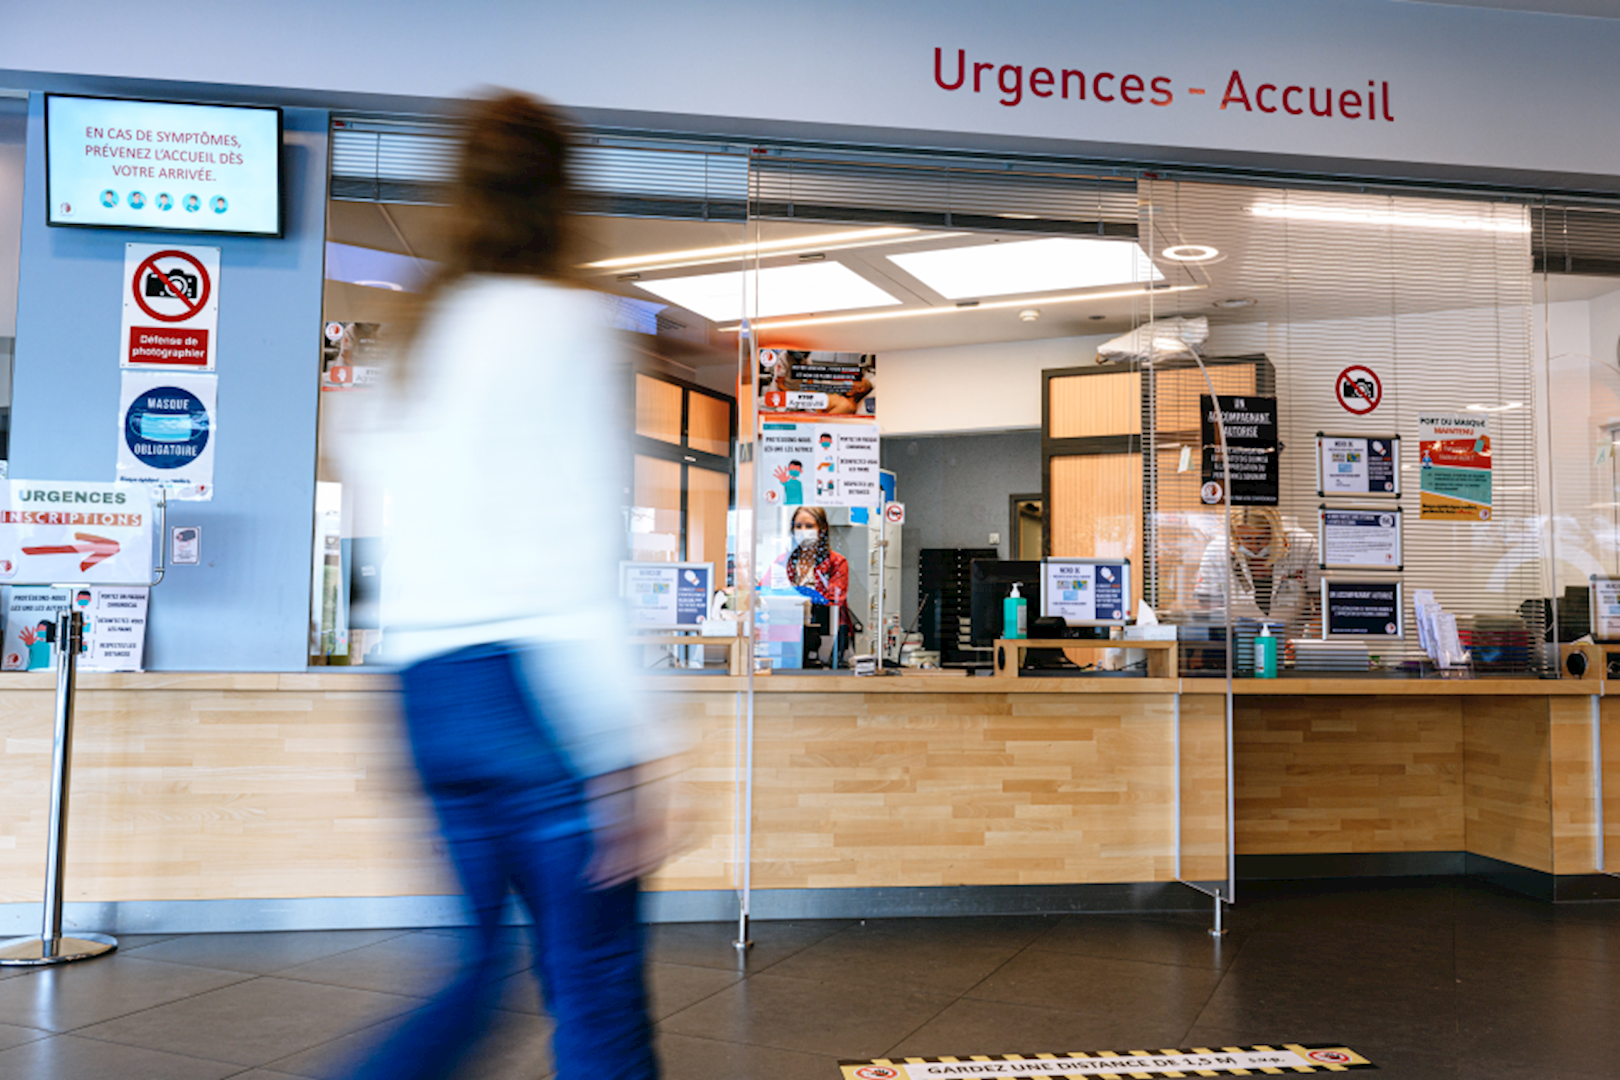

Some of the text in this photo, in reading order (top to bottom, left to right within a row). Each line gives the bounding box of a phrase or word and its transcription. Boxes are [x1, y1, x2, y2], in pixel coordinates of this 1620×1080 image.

[934, 47, 1174, 107] Urgences
[1220, 70, 1395, 122] Accueil
[86, 126, 242, 148] EN CAS DE SYMPTÔMES,
[85, 143, 244, 165] PRÉVENEZ L'ACCUEIL DÈS
[112, 165, 216, 182] VOTRE ARRIVÉE.
[140, 334, 198, 346] Défense de
[132, 346, 205, 359] photographier
[147, 397, 190, 410] MASQUE
[1454, 418, 1486, 427] MASQUE
[1434, 427, 1474, 436] MAINTENU
[134, 443, 198, 456] OBLIGATOIRE
[19, 489, 127, 504] URGENCES
[2, 511, 142, 526] INSCRIPTIONS
[928, 1064, 1008, 1074] GARDEZ
[1010, 1062, 1053, 1071] UNE
[1056, 1059, 1151, 1070] DISTANCE
[1153, 1058, 1180, 1067] DE
[1183, 1057, 1212, 1066] 1,5
